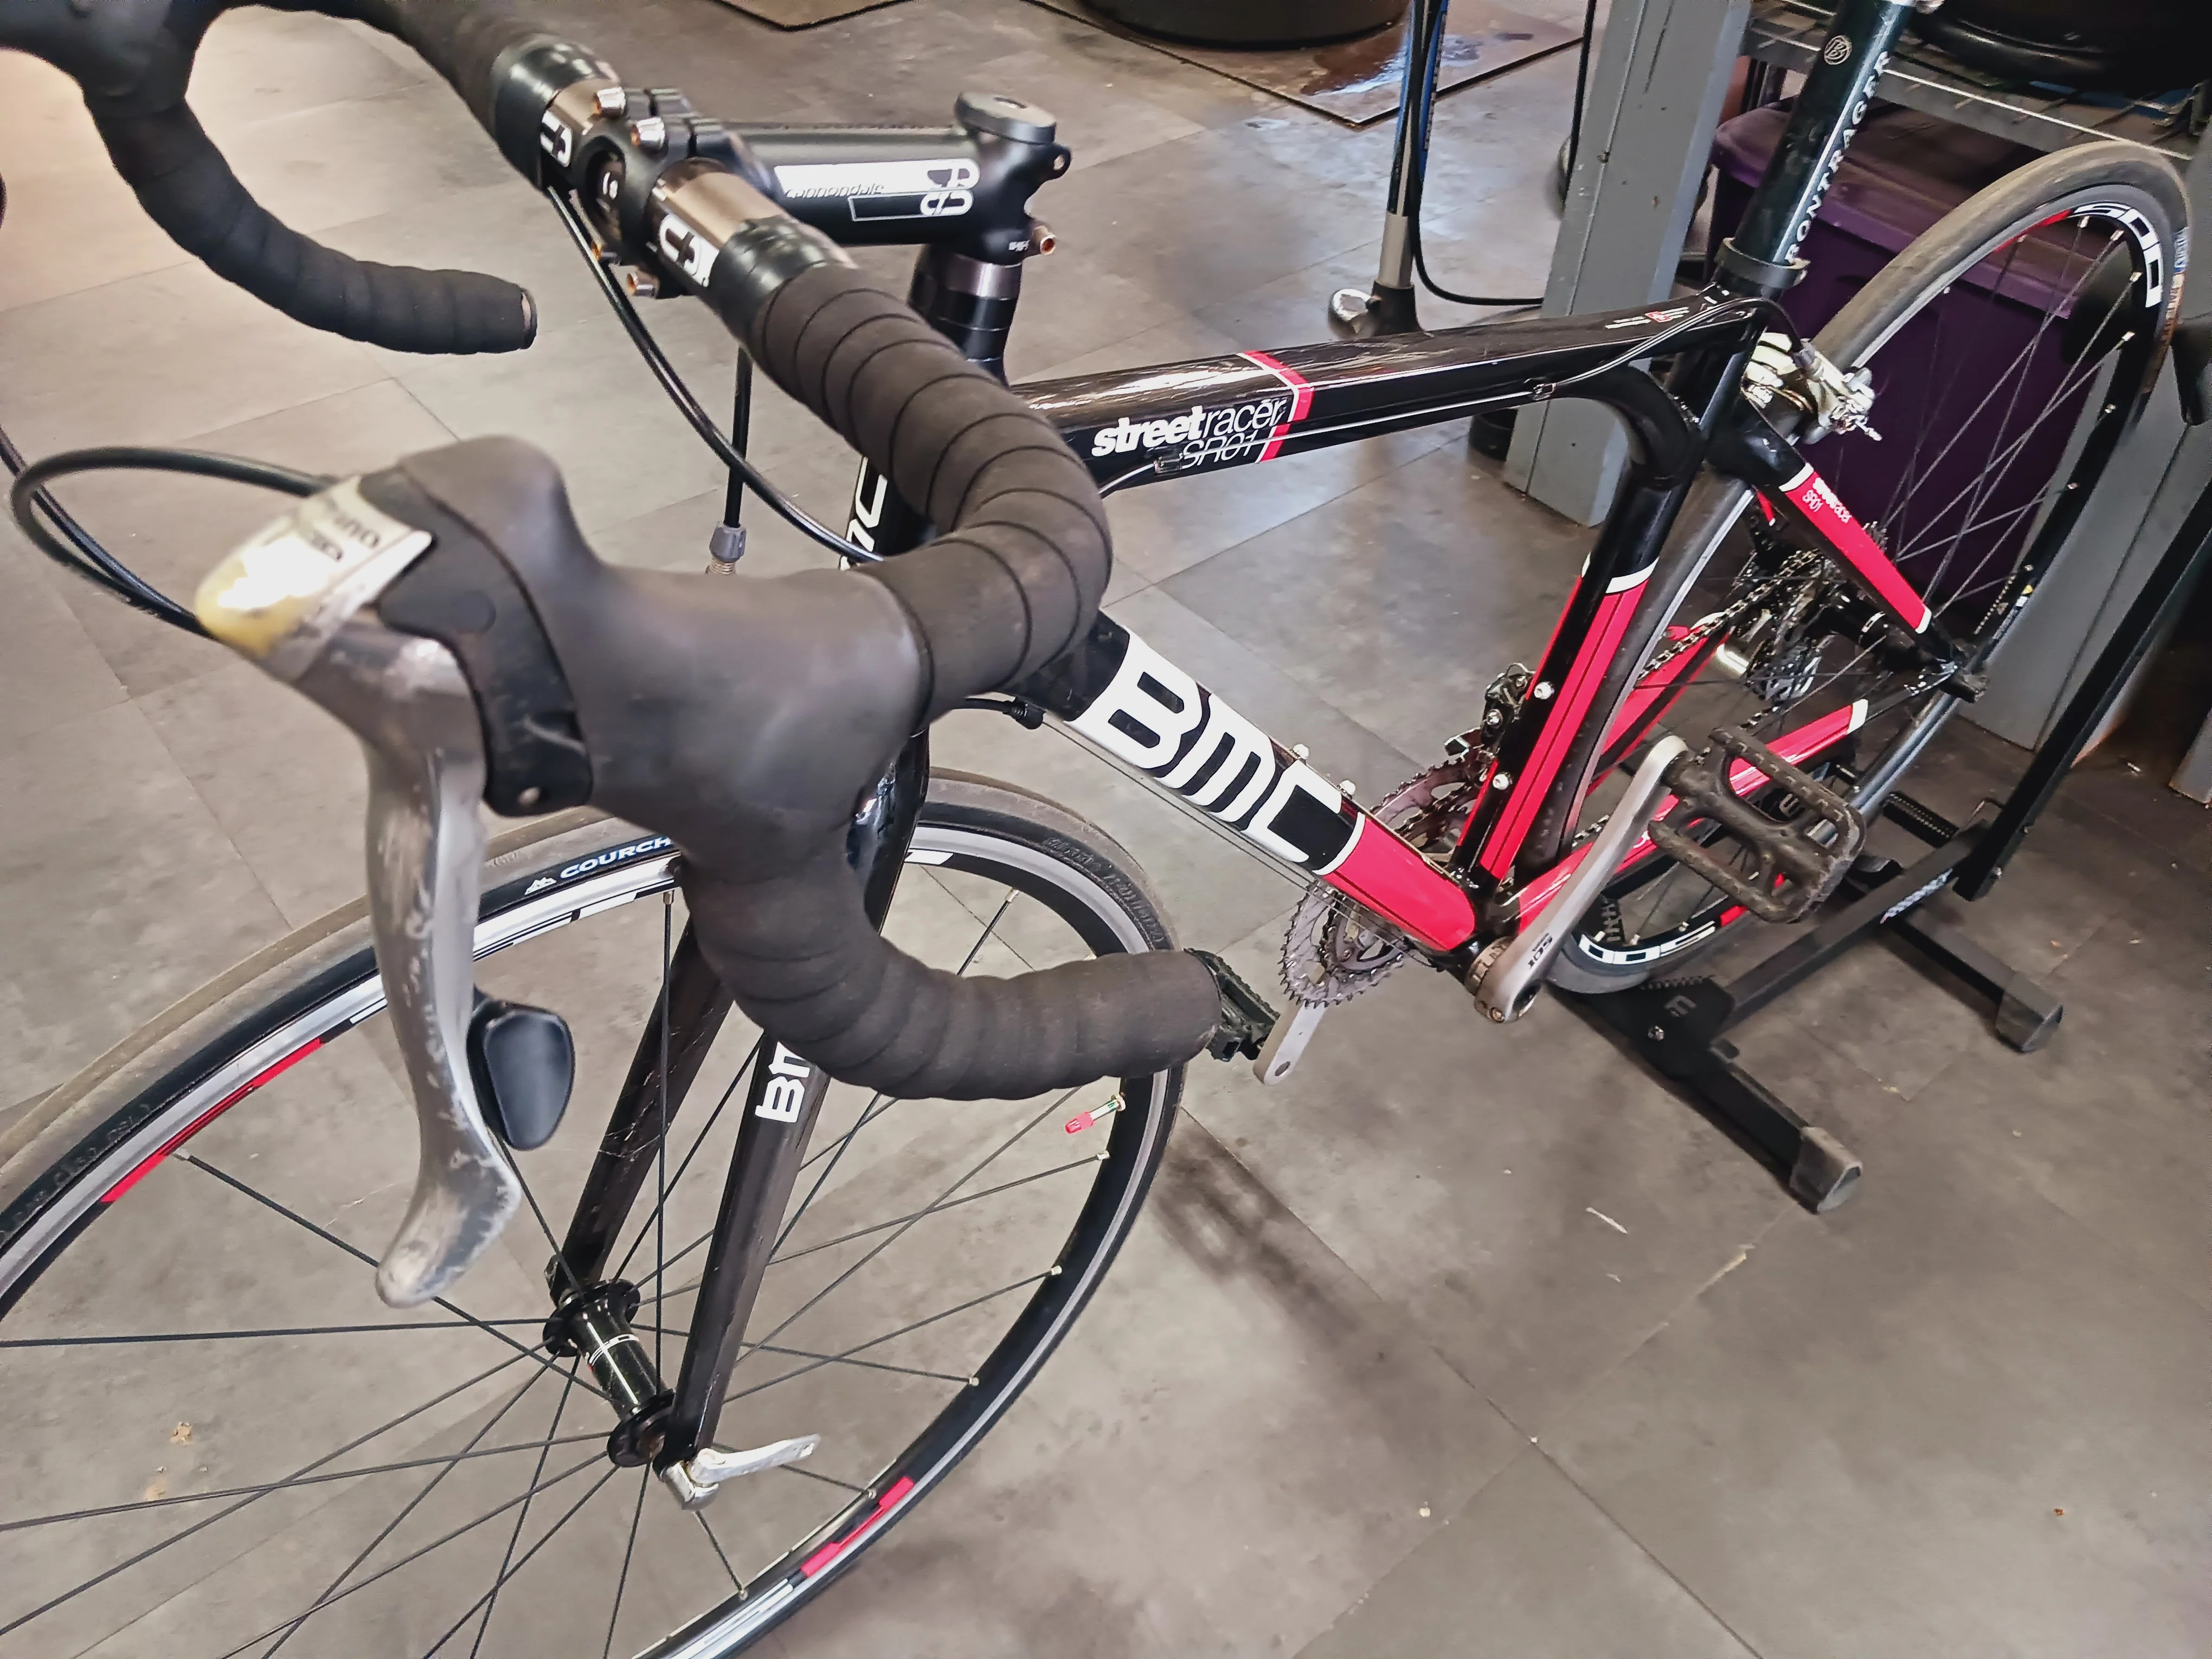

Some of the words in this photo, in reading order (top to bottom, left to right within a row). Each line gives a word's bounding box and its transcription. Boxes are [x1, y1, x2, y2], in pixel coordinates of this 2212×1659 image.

[1785, 51, 1891, 264] BONTRAGER
[786, 183, 884, 199] cannondale
[1091, 397, 1287, 457] streetracer
[1182, 430, 1258, 470] SR01
[1064, 625, 1342, 863] BMC
